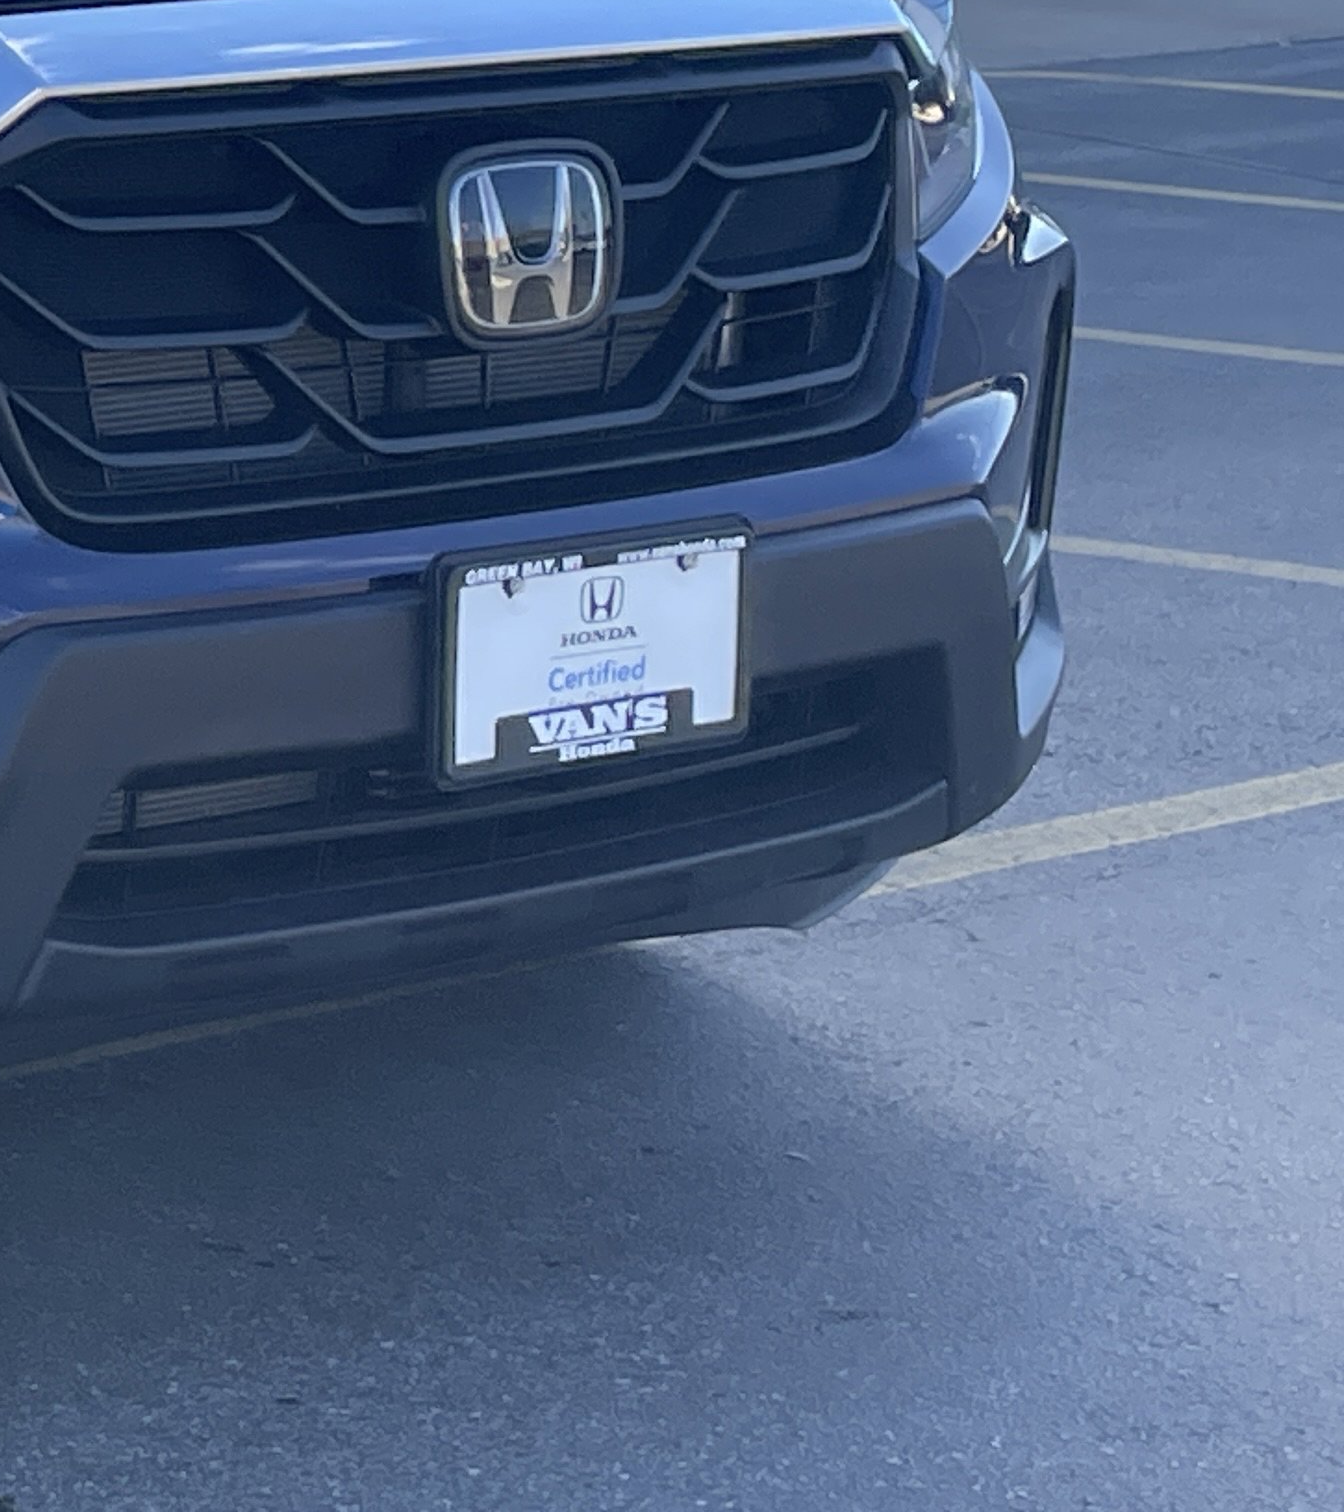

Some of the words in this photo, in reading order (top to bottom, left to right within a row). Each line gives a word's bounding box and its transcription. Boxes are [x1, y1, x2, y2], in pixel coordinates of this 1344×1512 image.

[465, 563, 519, 585] GREEN
[559, 625, 637, 648] HONDA
[548, 654, 646, 691] Certified
[559, 737, 636, 762] Honda
